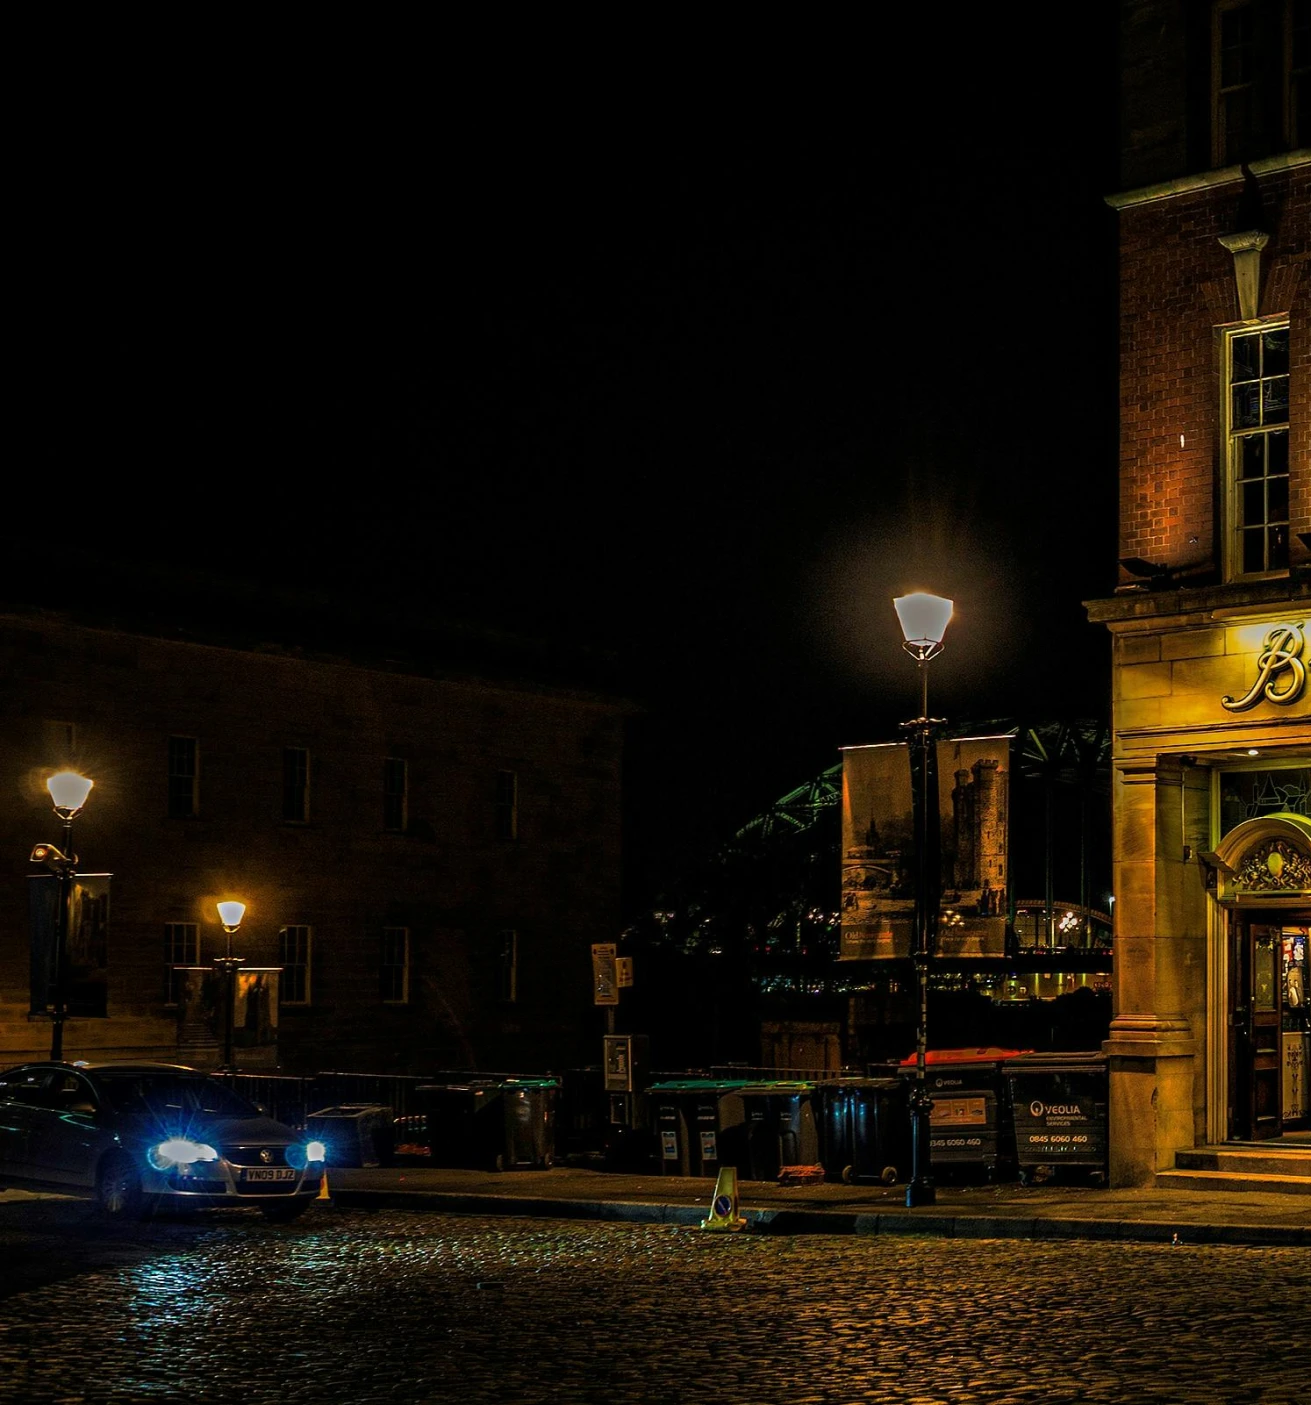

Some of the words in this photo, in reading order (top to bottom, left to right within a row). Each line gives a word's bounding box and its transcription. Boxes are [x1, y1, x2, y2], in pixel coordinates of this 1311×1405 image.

[1044, 1105, 1081, 1114] VEOLIA
[1029, 1135, 1049, 1143] 0845
[1050, 1135, 1071, 1143] 6060
